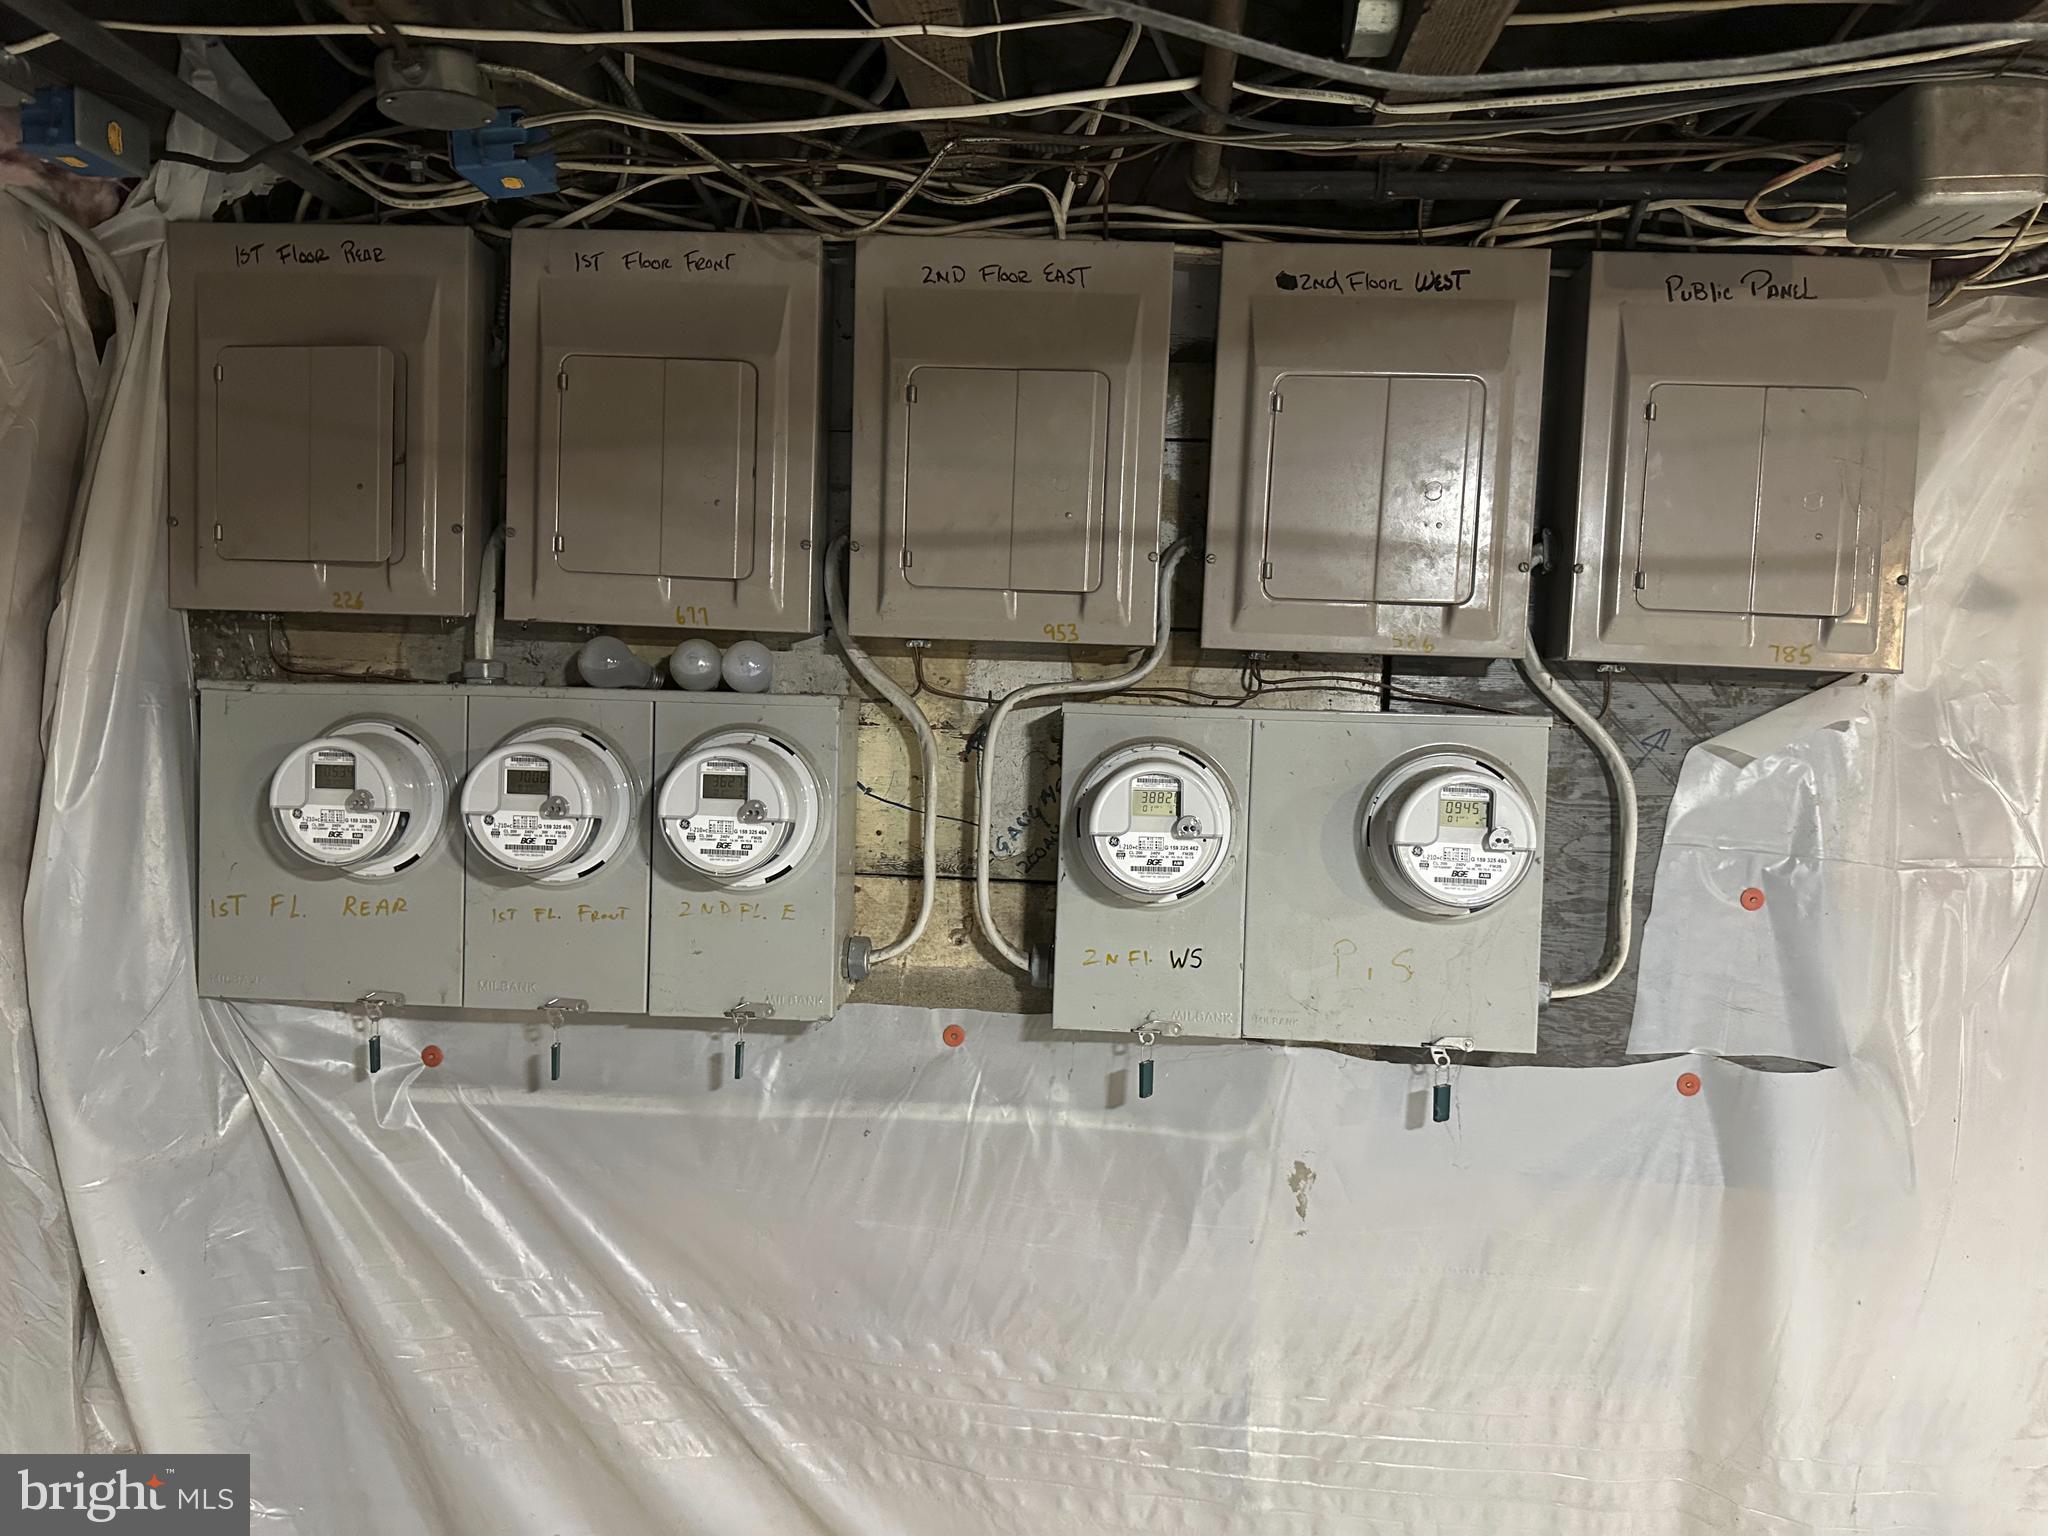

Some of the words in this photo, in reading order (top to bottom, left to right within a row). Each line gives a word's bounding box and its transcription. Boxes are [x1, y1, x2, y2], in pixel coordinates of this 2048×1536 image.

[921, 265, 966, 284] 2ND
[1043, 262, 1092, 288] EAST
[332, 591, 364, 609] 226
[675, 606, 709, 625] 677
[1043, 623, 1080, 642] 953
[1768, 643, 1812, 665] 785
[1445, 801, 1479, 815] 0945
[343, 895, 409, 917] REAR
[781, 904, 795, 920] E
[1169, 948, 1203, 969] WS
